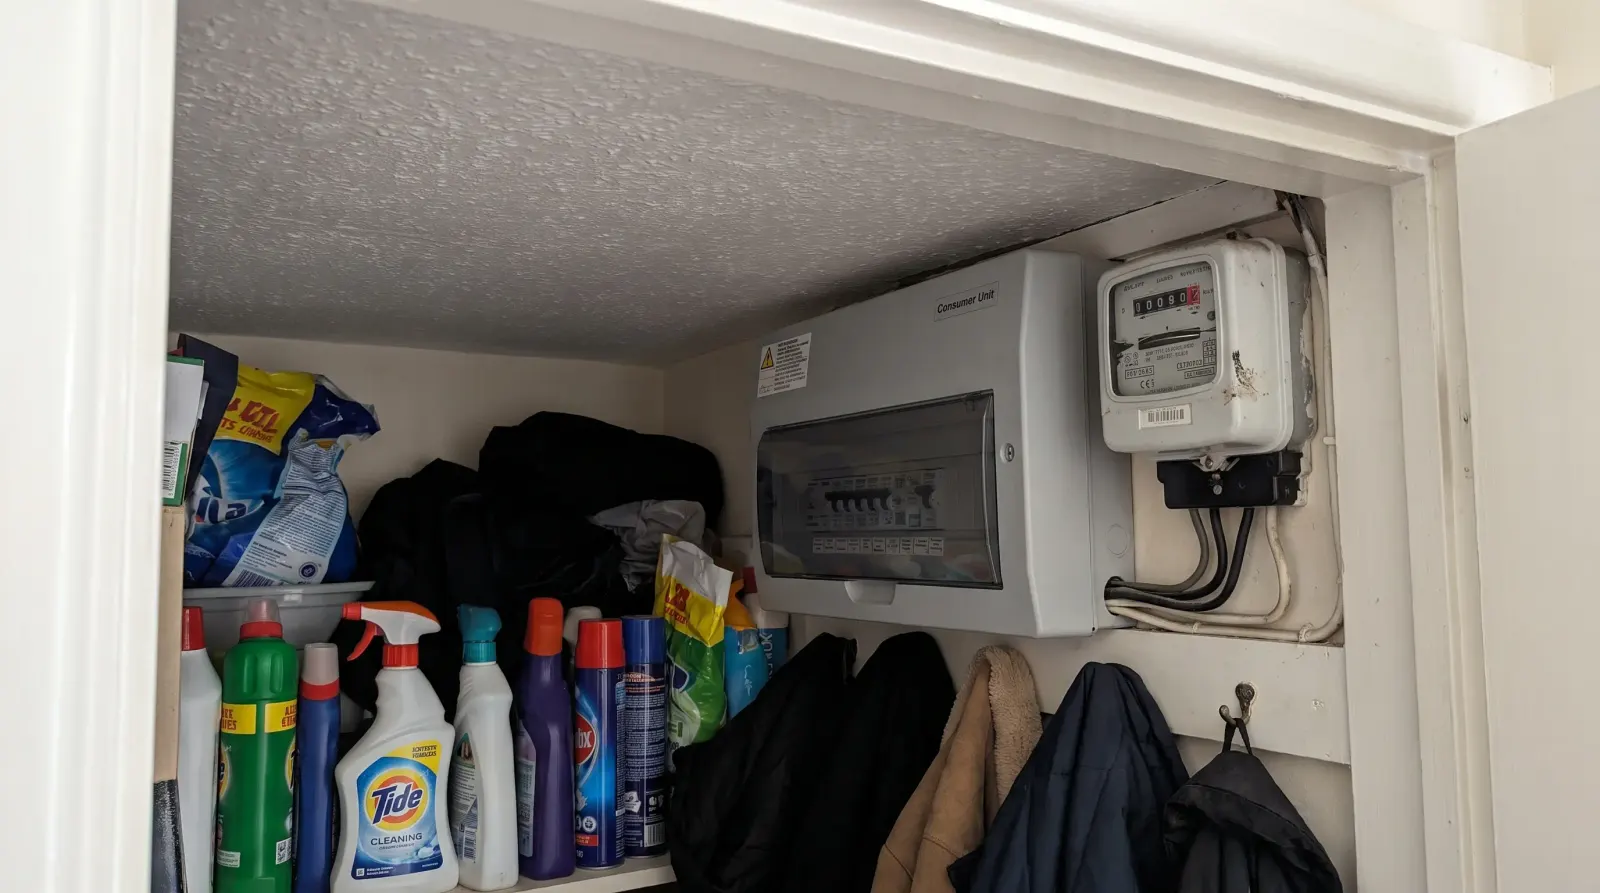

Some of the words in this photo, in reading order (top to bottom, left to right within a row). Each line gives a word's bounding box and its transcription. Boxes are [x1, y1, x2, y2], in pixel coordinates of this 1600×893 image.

[937, 296, 976, 314] Consumer
[978, 289, 995, 302] Unit
[371, 783, 424, 825] Tide
[370, 832, 423, 846] CLEANING
